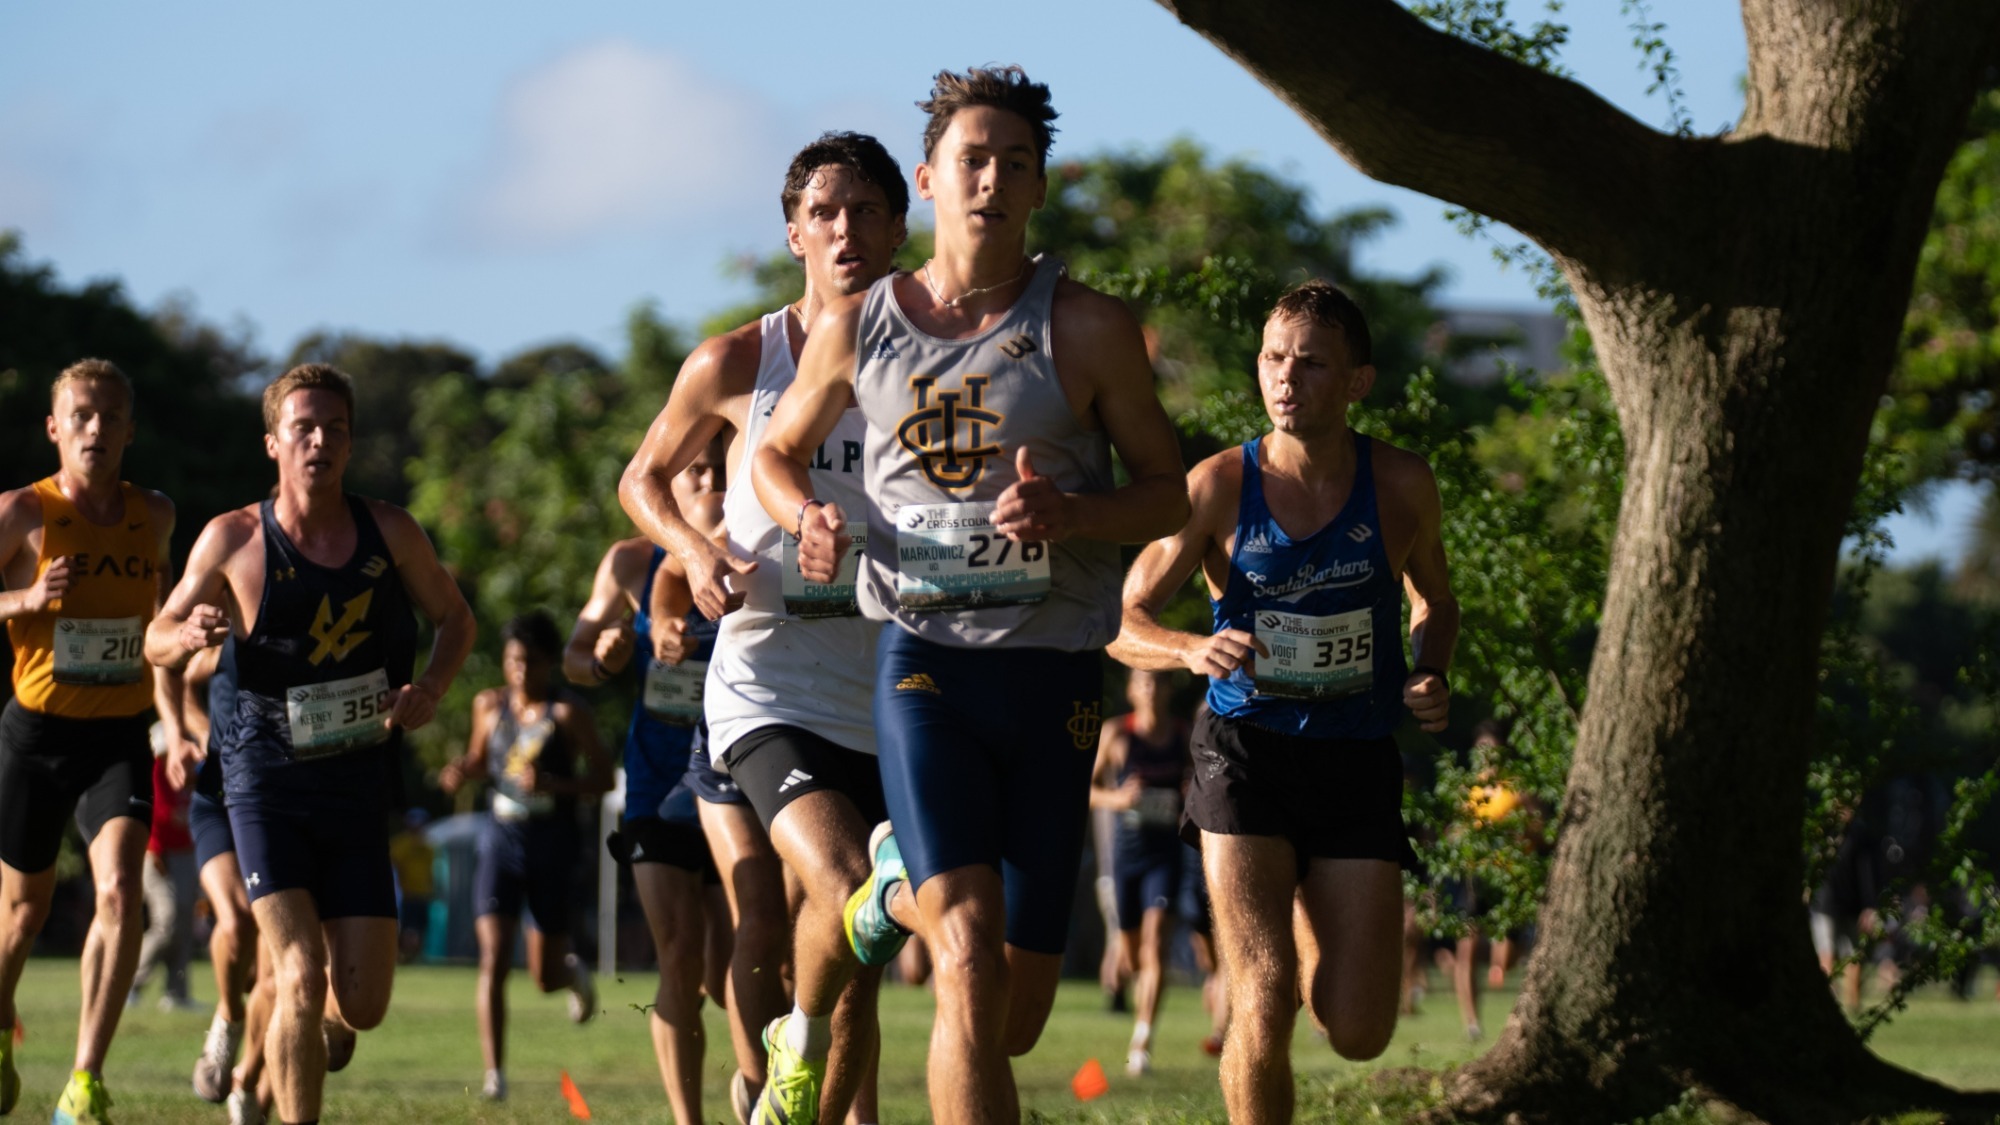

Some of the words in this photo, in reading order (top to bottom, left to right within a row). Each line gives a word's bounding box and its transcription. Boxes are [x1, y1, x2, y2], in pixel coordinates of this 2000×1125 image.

[809, 442, 833, 471] L
[842, 439, 865, 473] P
[927, 509, 950, 520] THE
[927, 519, 960, 529] CROSS
[961, 517, 991, 527] COUN
[851, 535, 868, 544] COU
[900, 544, 966, 562] MARKOWICZ
[1243, 545, 1273, 554] adidas
[73, 552, 155, 581] EACH
[921, 568, 1029, 588] CHAMPIONSHIPS
[1283, 615, 1303, 627] THE
[1282, 625, 1310, 636] CROSS
[1311, 624, 1350, 636] COUNTRY
[101, 634, 143, 661] 210
[1271, 644, 1298, 659] VOIGT
[1313, 632, 1372, 668] 335
[1273, 666, 1359, 682] CHAMPIONSHIPS
[311, 692, 337, 702] CROSS
[337, 685, 370, 698] COUNTRY
[896, 682, 942, 695] adidas
[300, 711, 333, 727] KEENEY
